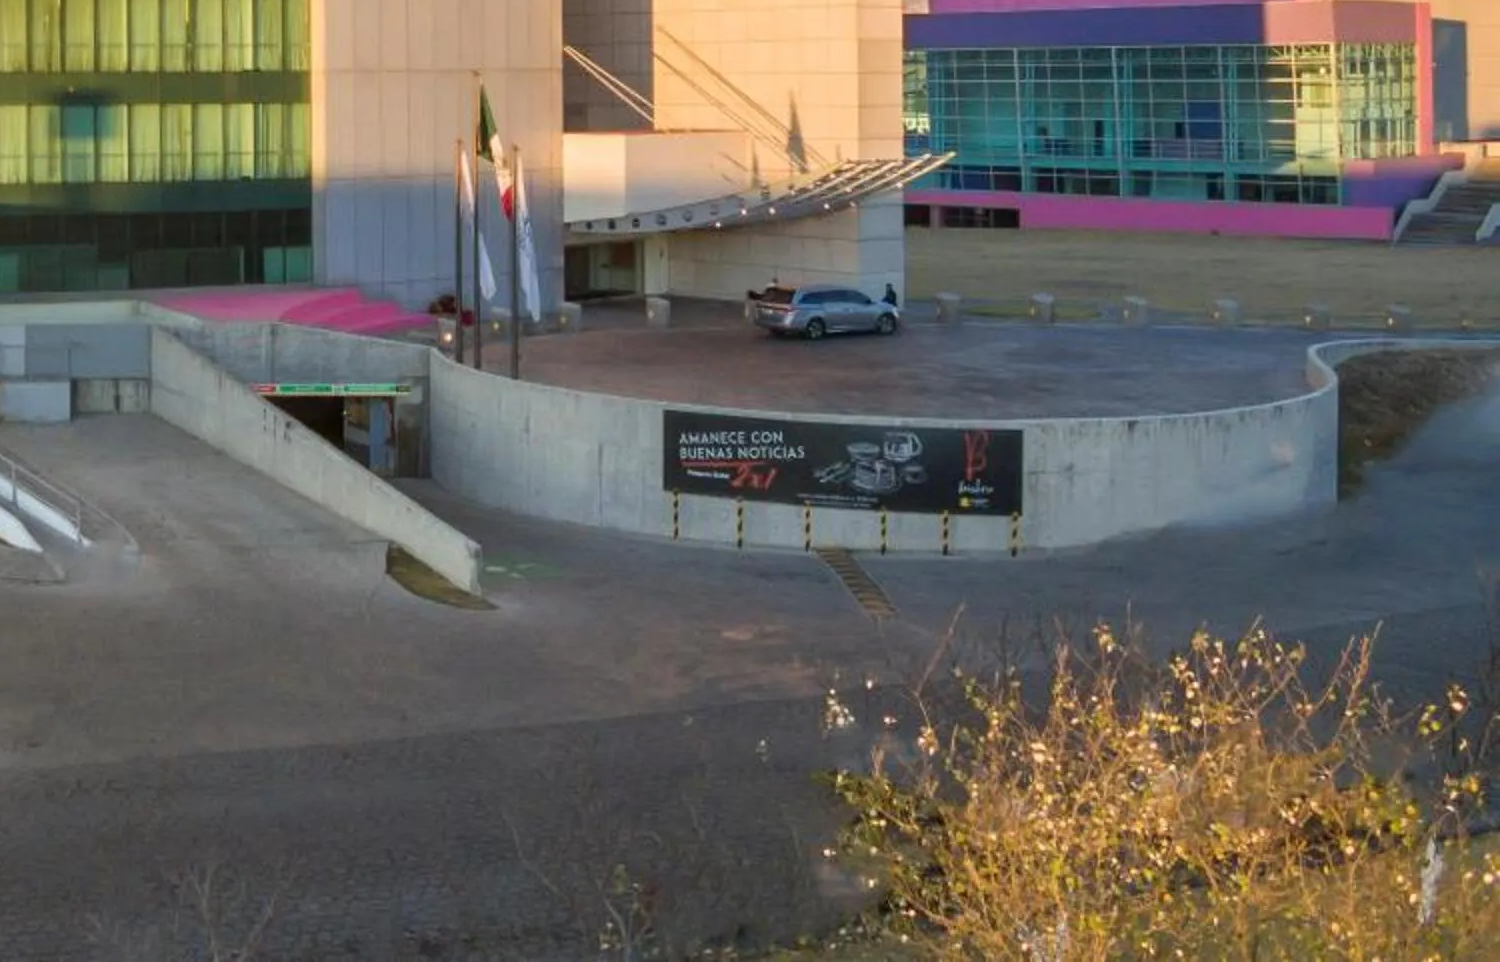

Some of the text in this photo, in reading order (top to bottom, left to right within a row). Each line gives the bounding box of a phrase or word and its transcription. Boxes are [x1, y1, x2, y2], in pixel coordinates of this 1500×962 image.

[679, 431, 784, 445] AMANECE CON
[679, 445, 806, 460] BUENAS NOTICIAS
